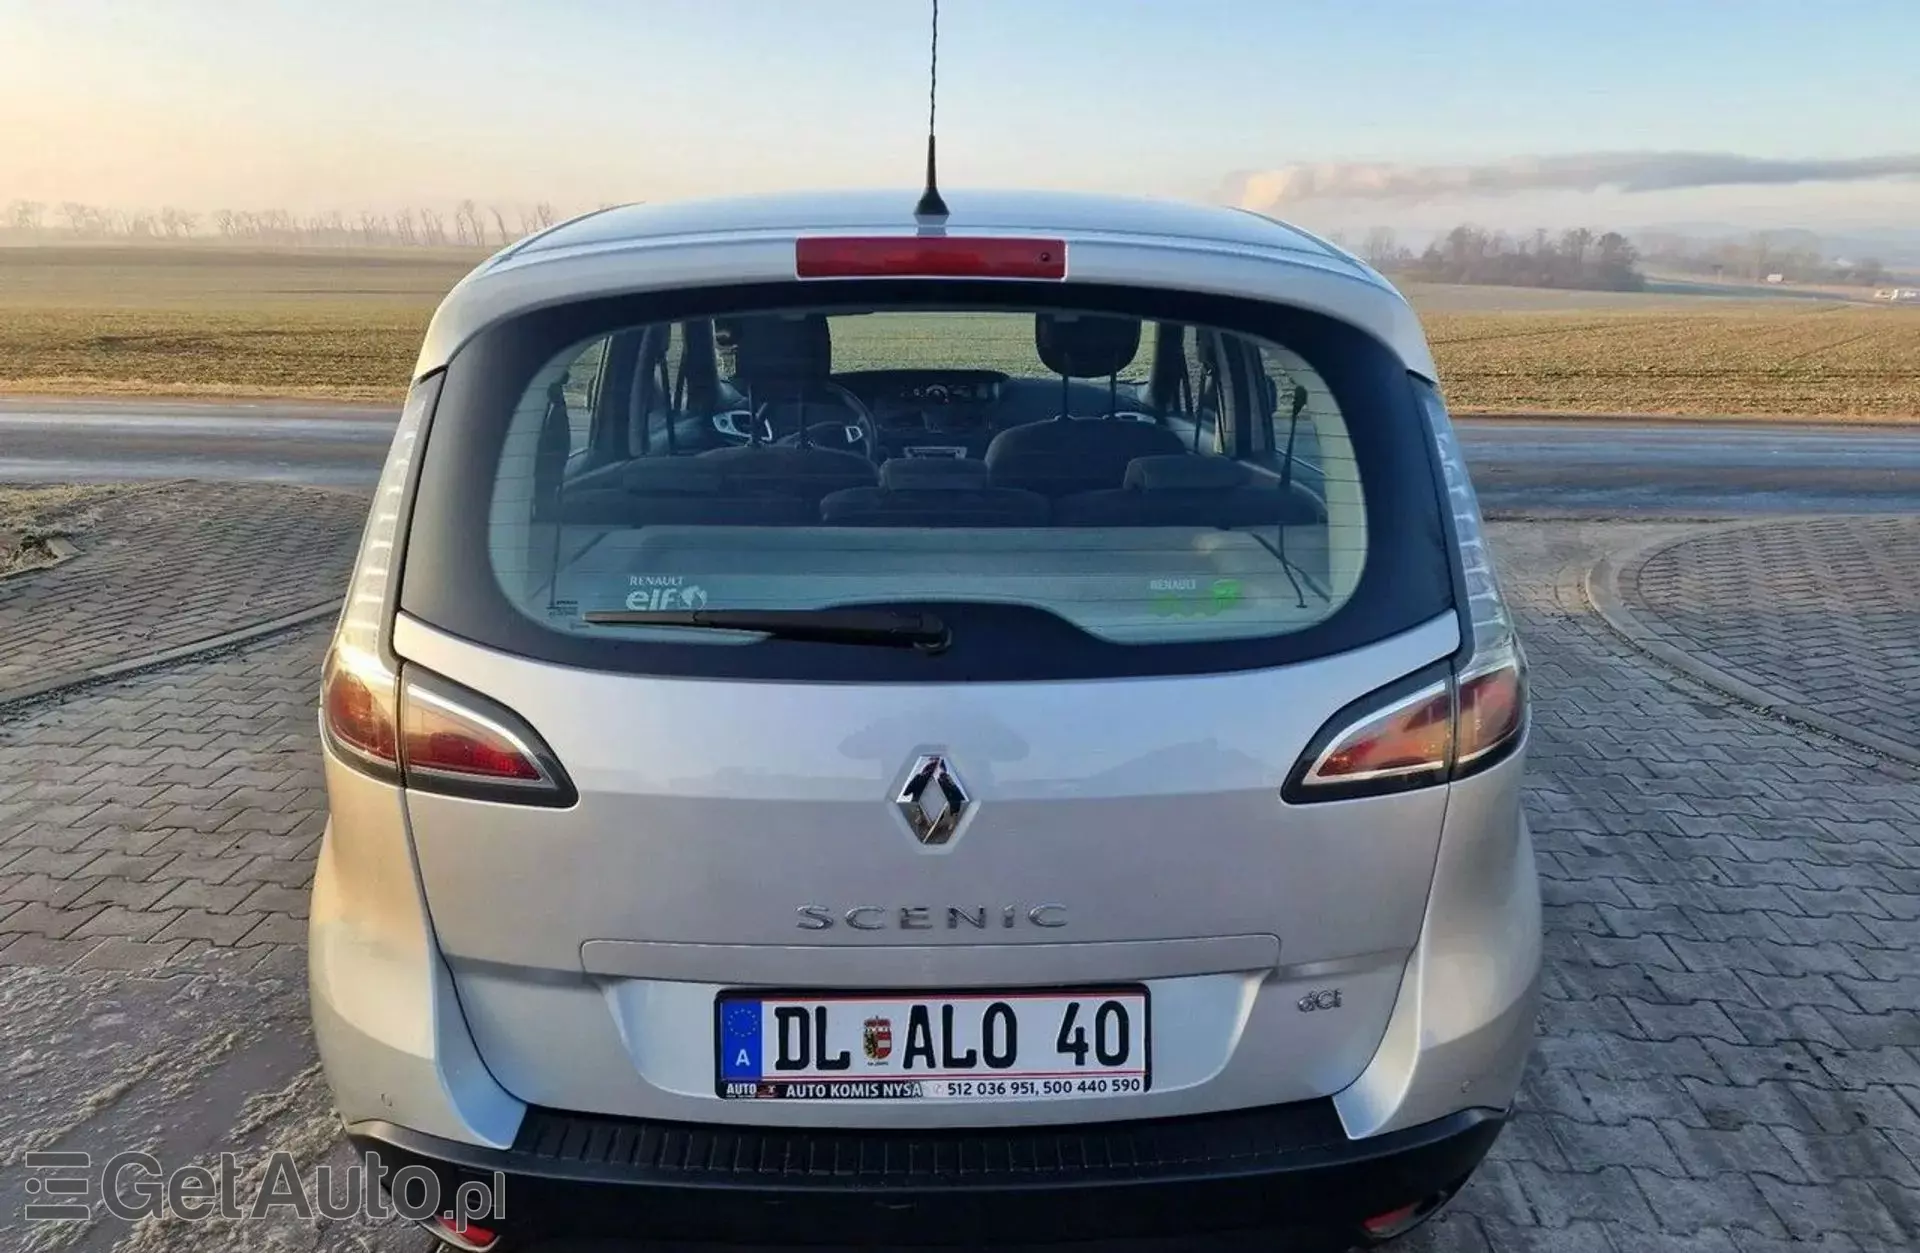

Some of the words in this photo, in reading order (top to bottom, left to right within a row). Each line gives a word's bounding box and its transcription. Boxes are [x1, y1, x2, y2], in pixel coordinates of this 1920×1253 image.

[628, 575, 683, 586] RENAULT
[626, 587, 677, 611] elf
[795, 903, 1069, 930] SCENIC
[774, 1006, 851, 1071] DL
[902, 1001, 1018, 1070] ALO
[1055, 1000, 1130, 1066] 40
[735, 1049, 751, 1067] A
[726, 1083, 757, 1095] AUTO
[786, 1084, 827, 1098] AUTO
[830, 1083, 880, 1098] KOMIS
[883, 1082, 923, 1097] NYSA
[948, 1082, 972, 1096] 512
[977, 1082, 1006, 1095] 036
[1010, 1081, 1039, 1096] 951,
[1043, 1080, 1072, 1094] 500
[1077, 1080, 1107, 1092] 440
[1111, 1078, 1140, 1091] 590
